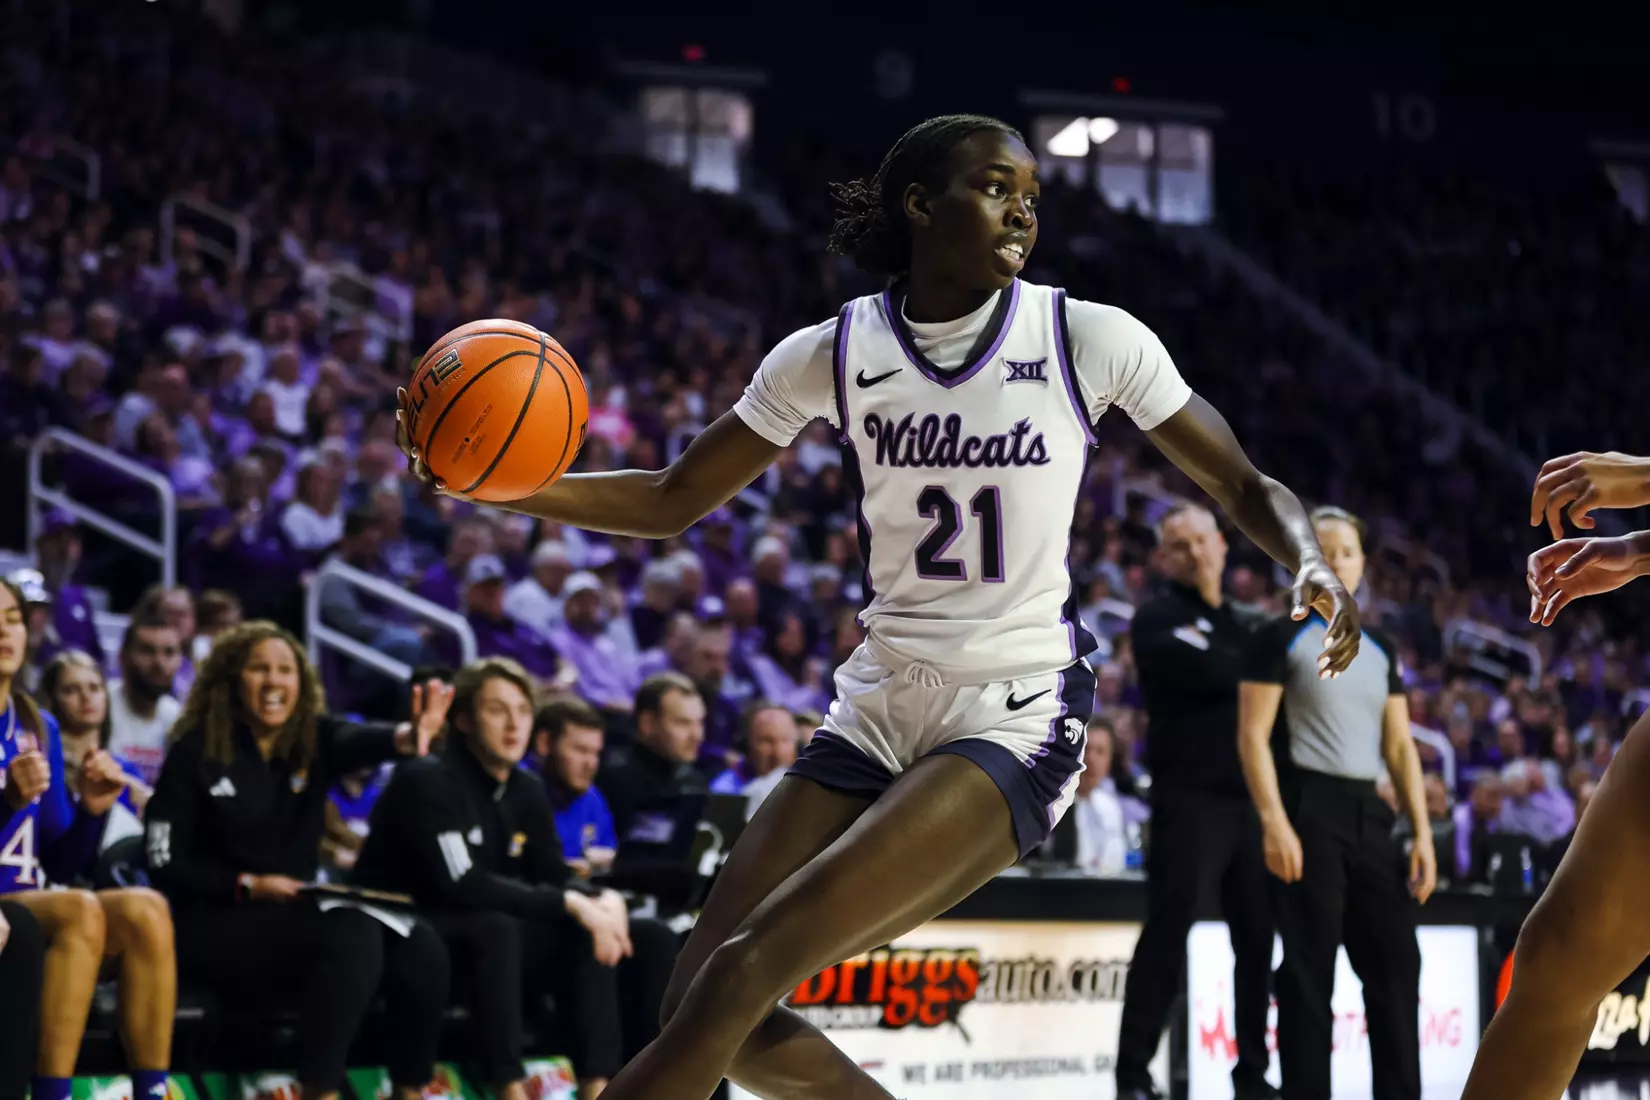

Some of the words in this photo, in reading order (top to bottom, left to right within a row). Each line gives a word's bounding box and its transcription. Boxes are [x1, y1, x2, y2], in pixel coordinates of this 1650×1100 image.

[872, 49, 914, 98] 9
[1371, 91, 1437, 141] 10
[1004, 358, 1048, 383] XII
[864, 411, 1051, 468] Wildcats
[915, 485, 1005, 583] 21
[0, 815, 40, 884] 4
[901, 1062, 927, 1085] WE
[934, 1060, 964, 1083] ARE
[970, 1055, 1086, 1080] PROFESSIONAL
